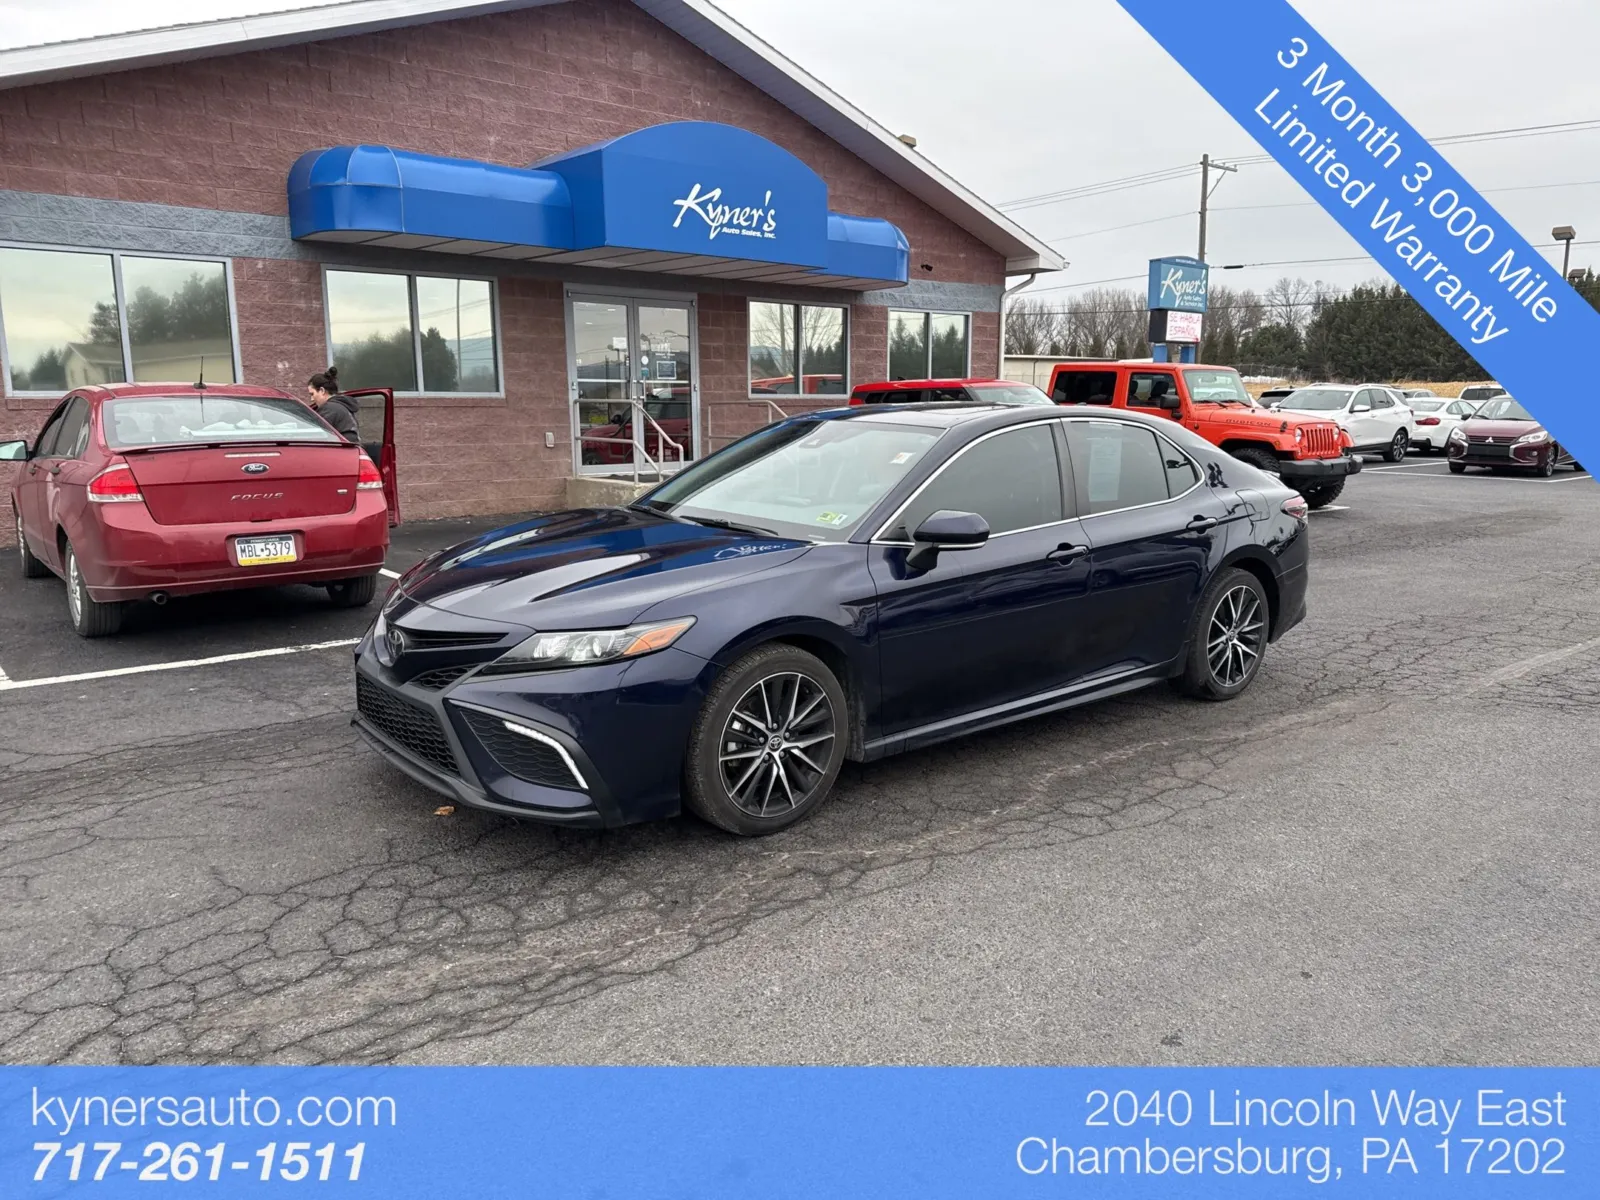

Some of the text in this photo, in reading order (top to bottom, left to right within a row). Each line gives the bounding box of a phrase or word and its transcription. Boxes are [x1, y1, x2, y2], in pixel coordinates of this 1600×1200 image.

[673, 183, 776, 240] Kyner's
[722, 226, 740, 235] Auto
[741, 229, 762, 238] Sales,
[1160, 268, 1206, 307] Kyner's
[247, 464, 264, 472] Ford
[231, 492, 284, 501] FOCUS
